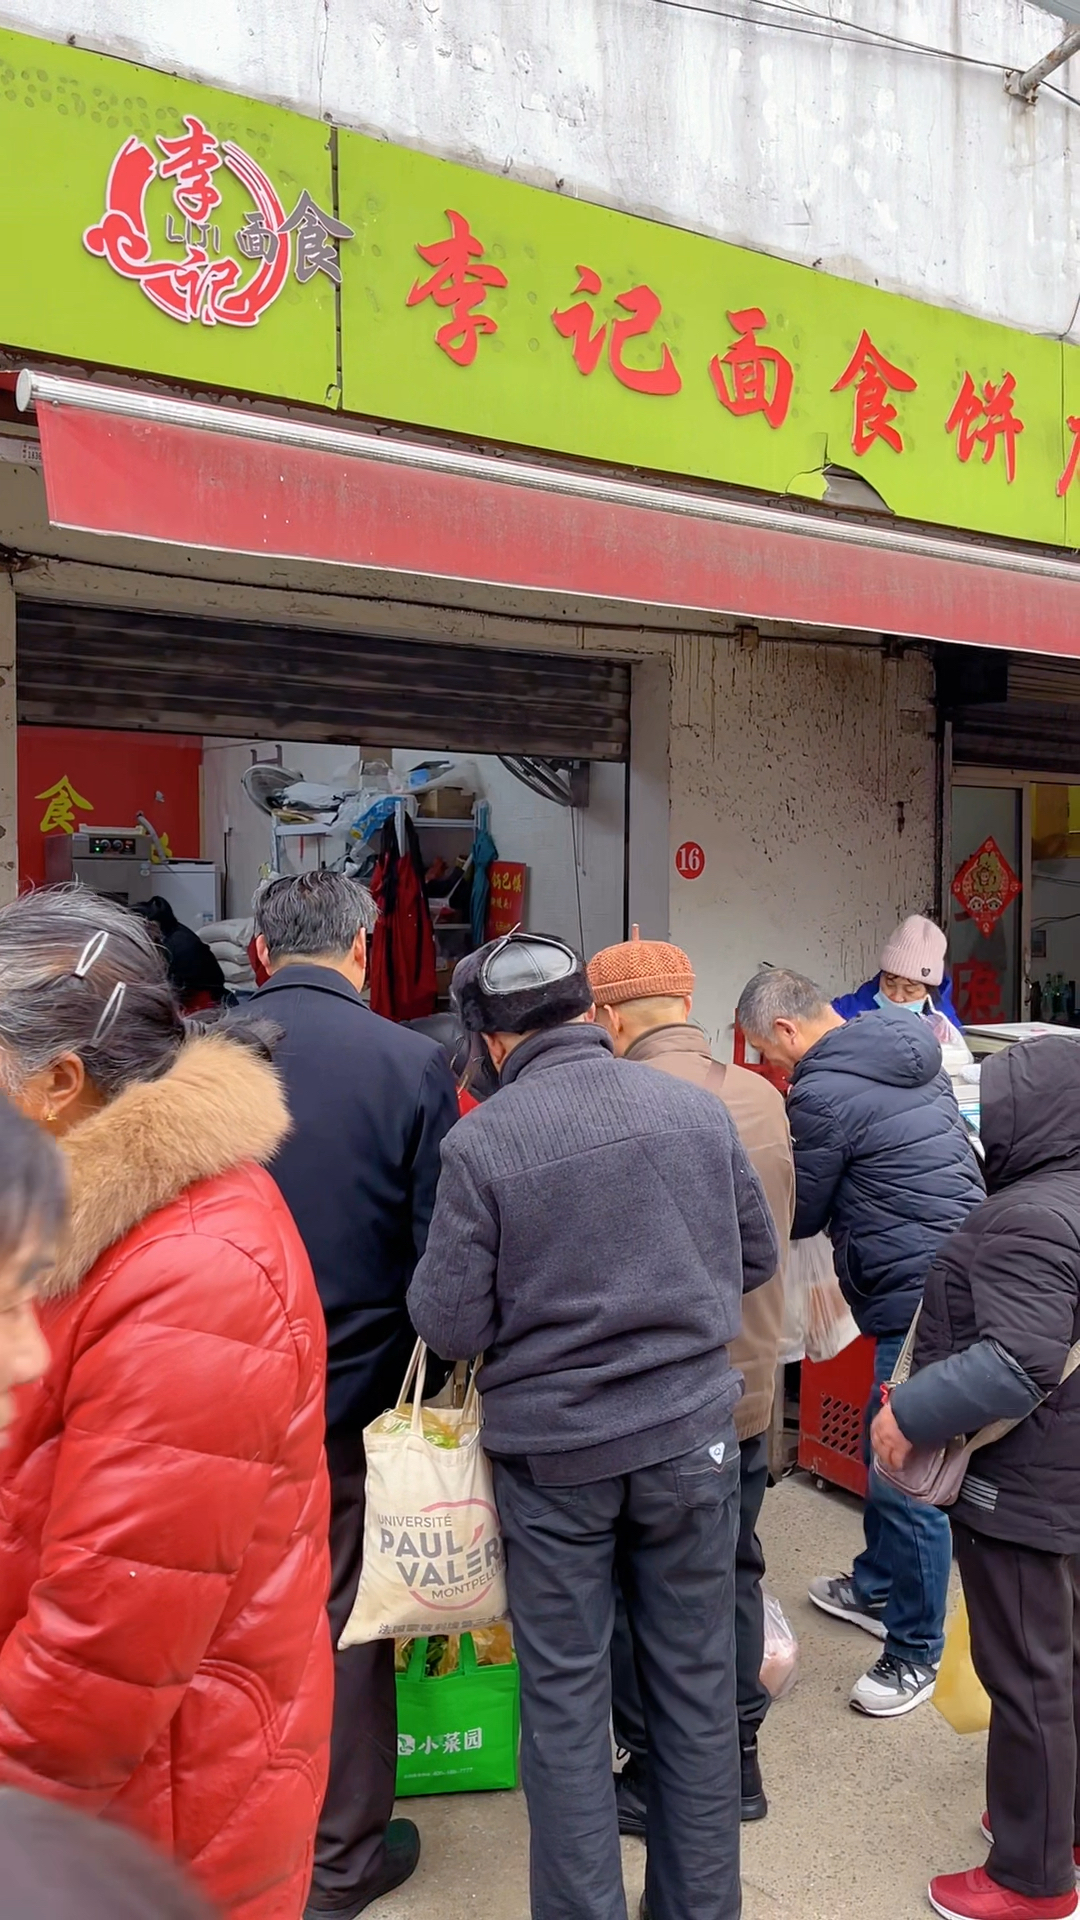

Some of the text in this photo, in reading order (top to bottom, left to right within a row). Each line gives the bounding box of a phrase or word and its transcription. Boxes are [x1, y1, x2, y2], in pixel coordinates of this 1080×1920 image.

[235, 189, 355, 283] 面食
[34, 775, 94, 834] 食
[679, 847, 701, 871] 16
[378, 1513, 453, 1528] UNIVERSITÉ
[380, 1528, 463, 1559] PAUL
[417, 1726, 483, 1756] 小菜园
